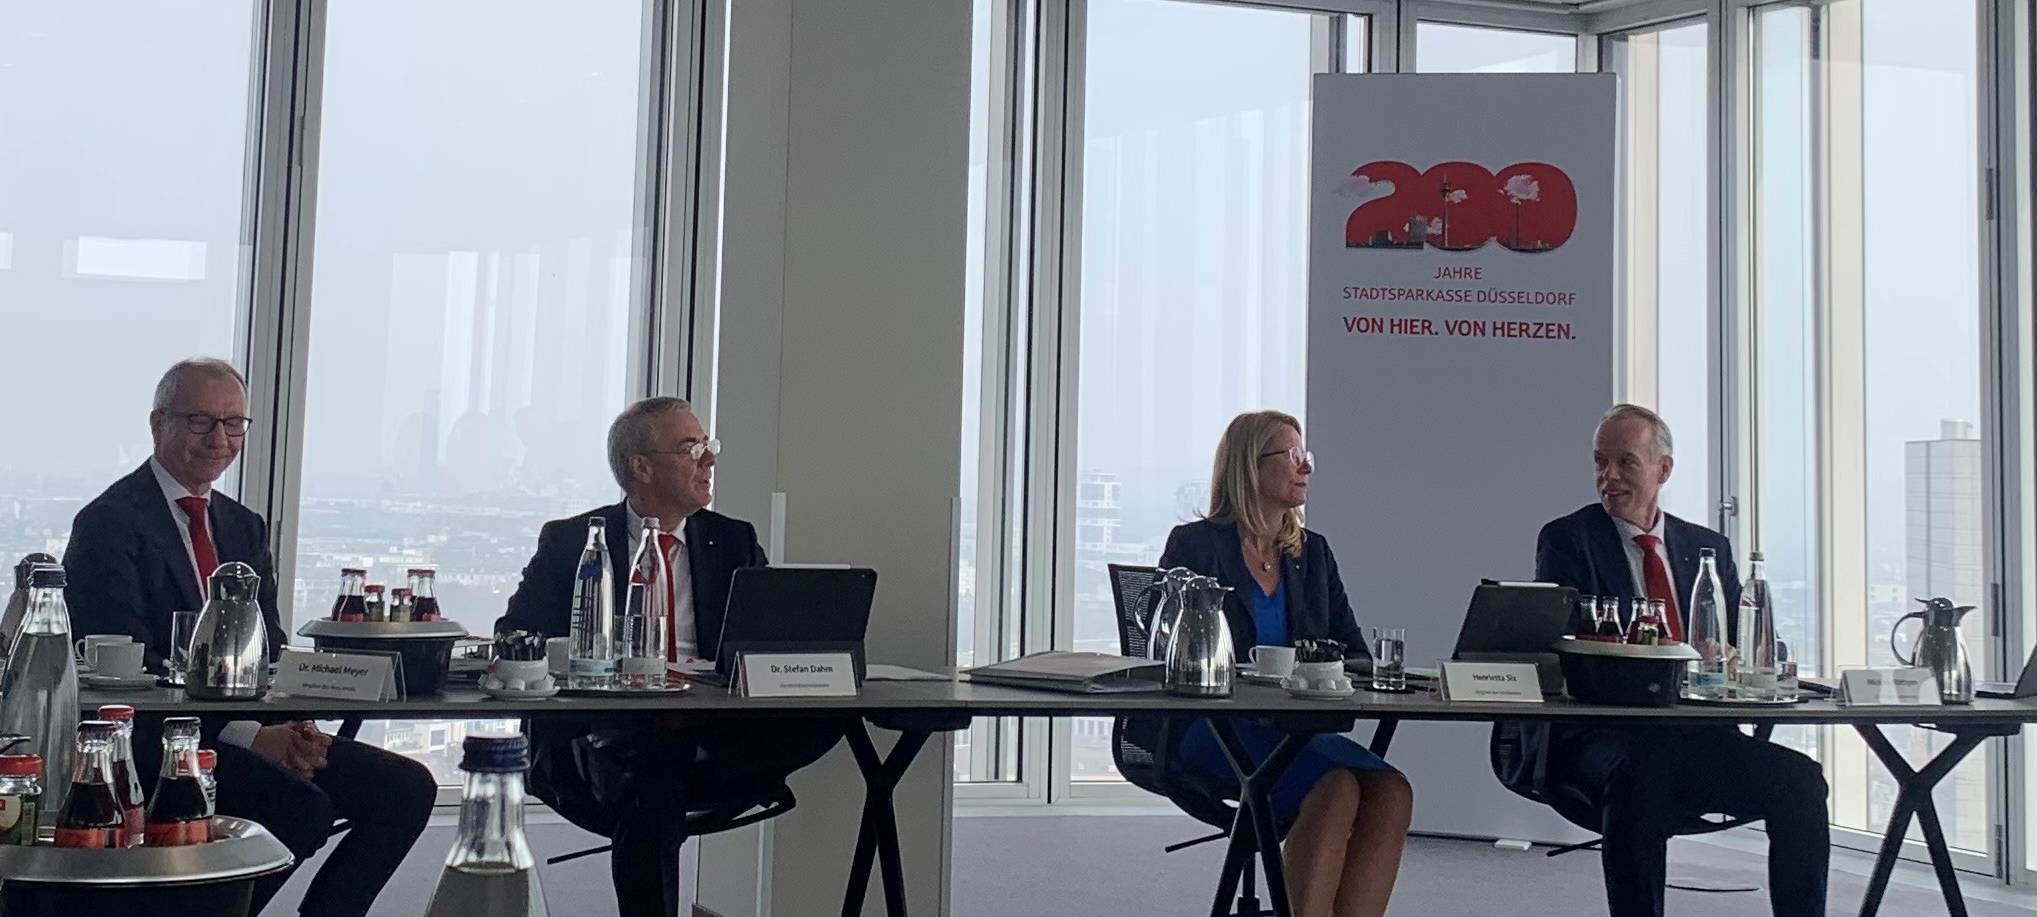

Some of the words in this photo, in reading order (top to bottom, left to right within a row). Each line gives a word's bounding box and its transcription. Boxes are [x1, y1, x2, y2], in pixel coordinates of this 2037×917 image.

[1346, 160, 1577, 253] 200
[1433, 267, 1482, 281] JAHRE
[1343, 287, 1472, 303] STADTSPARKASSE
[1477, 288, 1577, 305] DÜSSELDORF
[1343, 317, 1384, 334] VON
[1390, 319, 1438, 336] HIER.
[1445, 320, 1486, 337] VON
[1492, 322, 1577, 340] HERZEN.
[299, 663, 309, 672] Dr.
[311, 664, 342, 675] Michael
[343, 666, 369, 678] Meyer
[771, 665, 782, 673] Dr.
[784, 664, 809, 673] Stefan
[811, 665, 833, 673] Dahm
